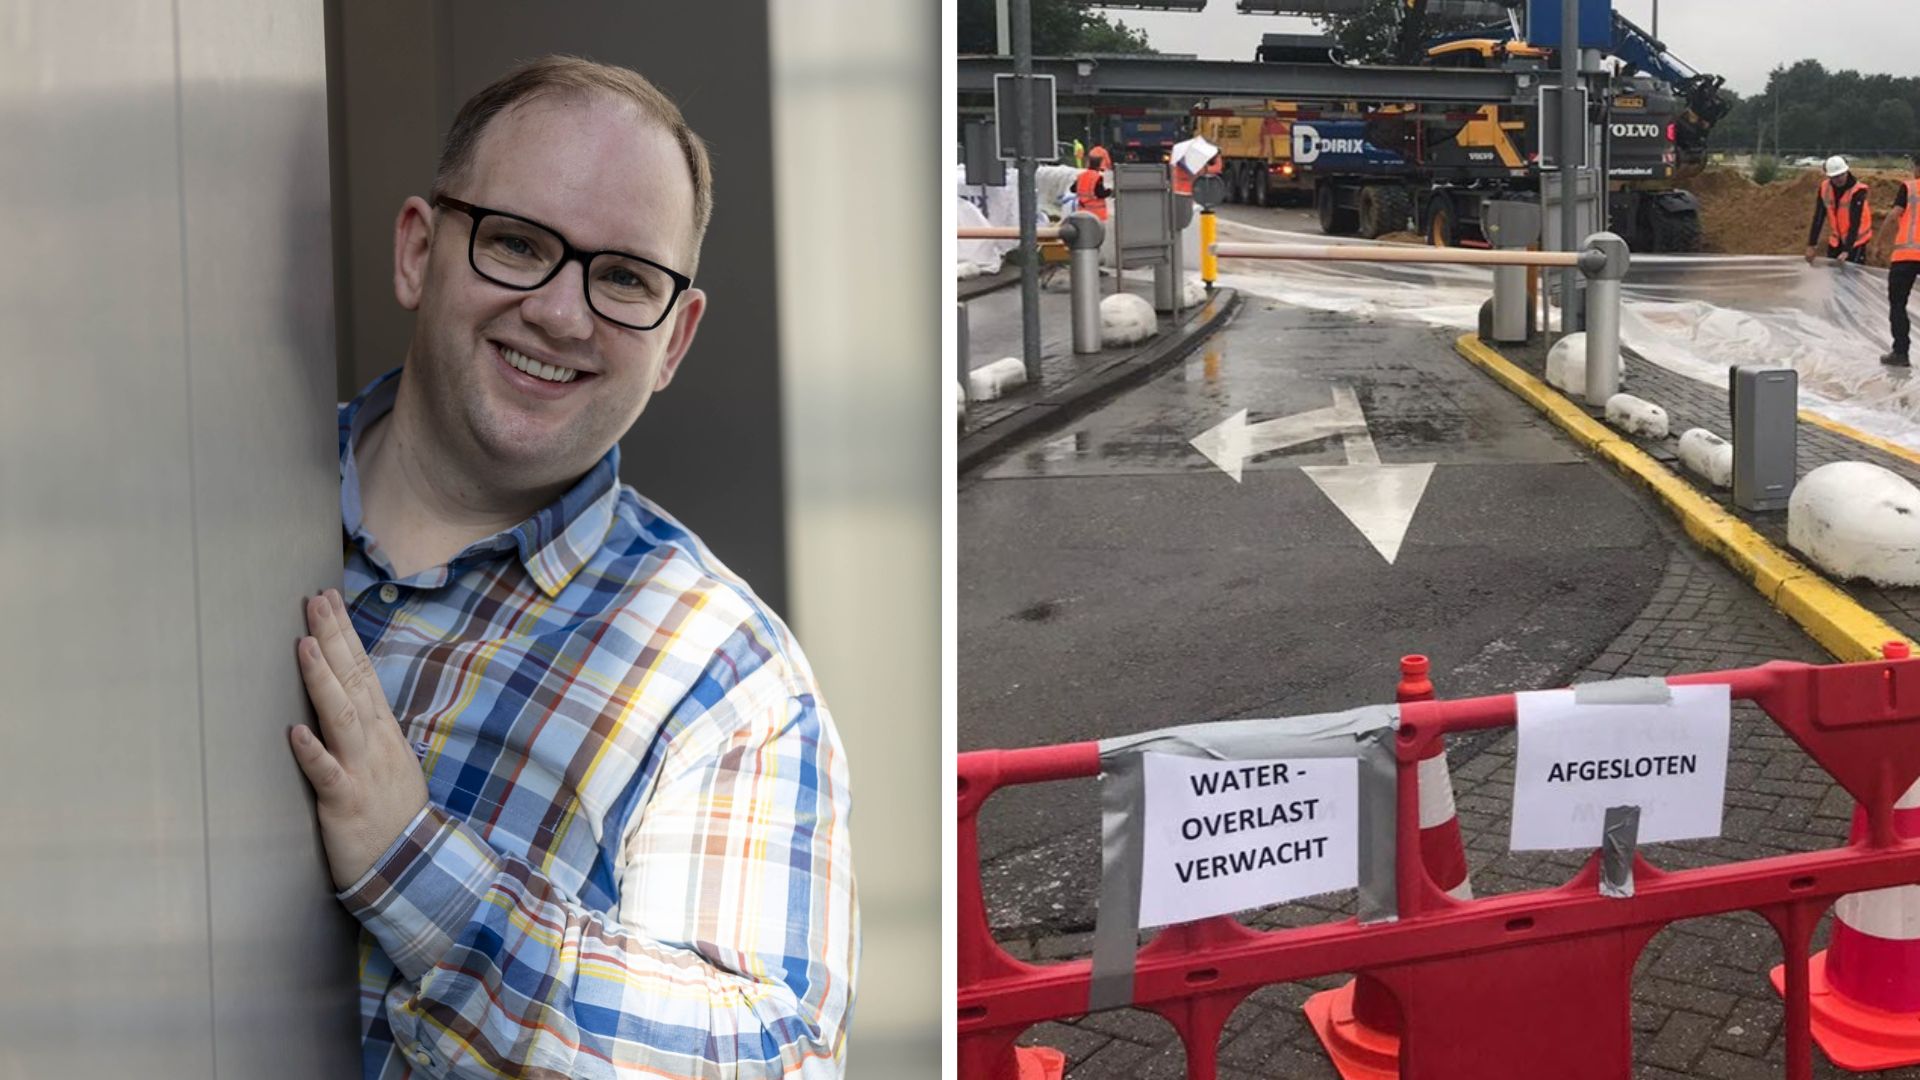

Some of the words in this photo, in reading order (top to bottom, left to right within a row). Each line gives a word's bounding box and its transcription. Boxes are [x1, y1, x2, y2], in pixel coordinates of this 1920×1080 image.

[1609, 124, 1660, 138] OLVO
[1321, 138, 1365, 154] DIRIX
[1468, 152, 1494, 160] VOLVO
[1190, 763, 1289, 797] WATER
[1547, 754, 1697, 783] AFGESLOTEN
[1181, 798, 1320, 841] OVERLAST
[1174, 836, 1329, 884] VERWACHT
